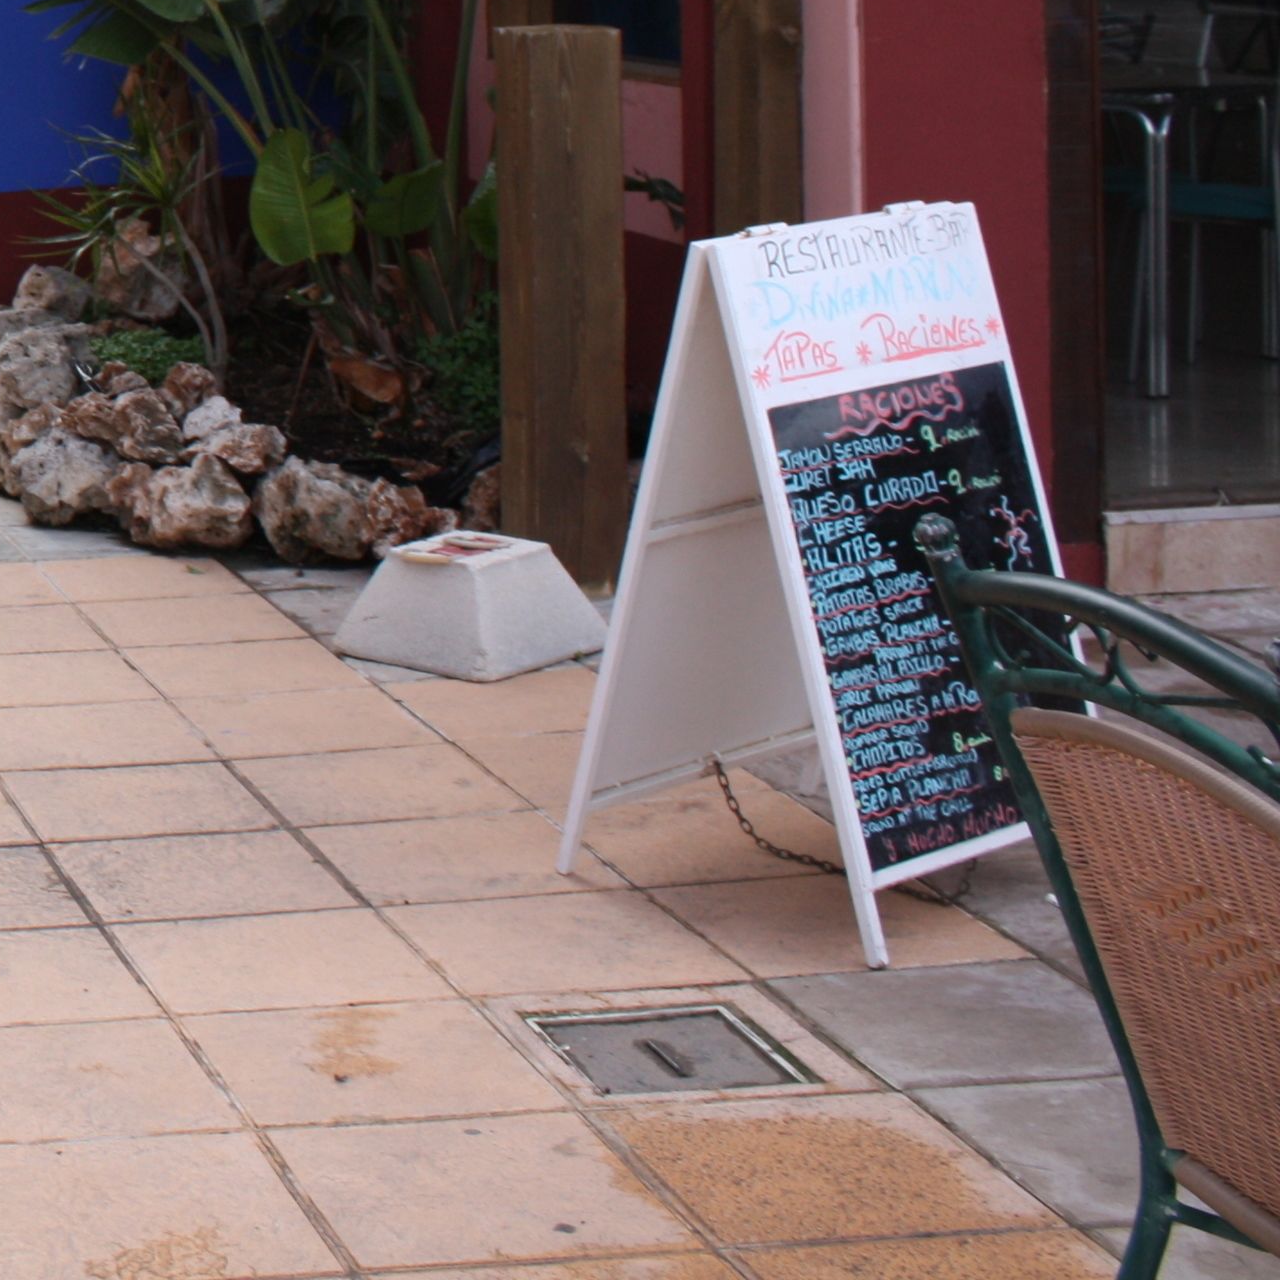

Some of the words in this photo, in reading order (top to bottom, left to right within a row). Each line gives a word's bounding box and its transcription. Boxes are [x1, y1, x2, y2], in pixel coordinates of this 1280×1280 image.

[764, 330, 838, 376] TAPAS
[838, 372, 963, 421] RACIONES
[778, 445, 831, 470] JAMON
[834, 434, 903, 461] SERRANO
[792, 491, 856, 524] QUESO
[865, 470, 941, 508] CURADO
[798, 514, 866, 548] CHEESE
[806, 533, 882, 572] ALITAS
[813, 585, 875, 616] PATATAS
[825, 629, 880, 657] GAMBAS
[881, 615, 939, 643] PLANCHA
[842, 695, 929, 730] CALAMARES
[852, 736, 925, 771] CHOPITOS
[860, 786, 903, 814] SEPIA
[907, 770, 972, 802] PLANCHA
